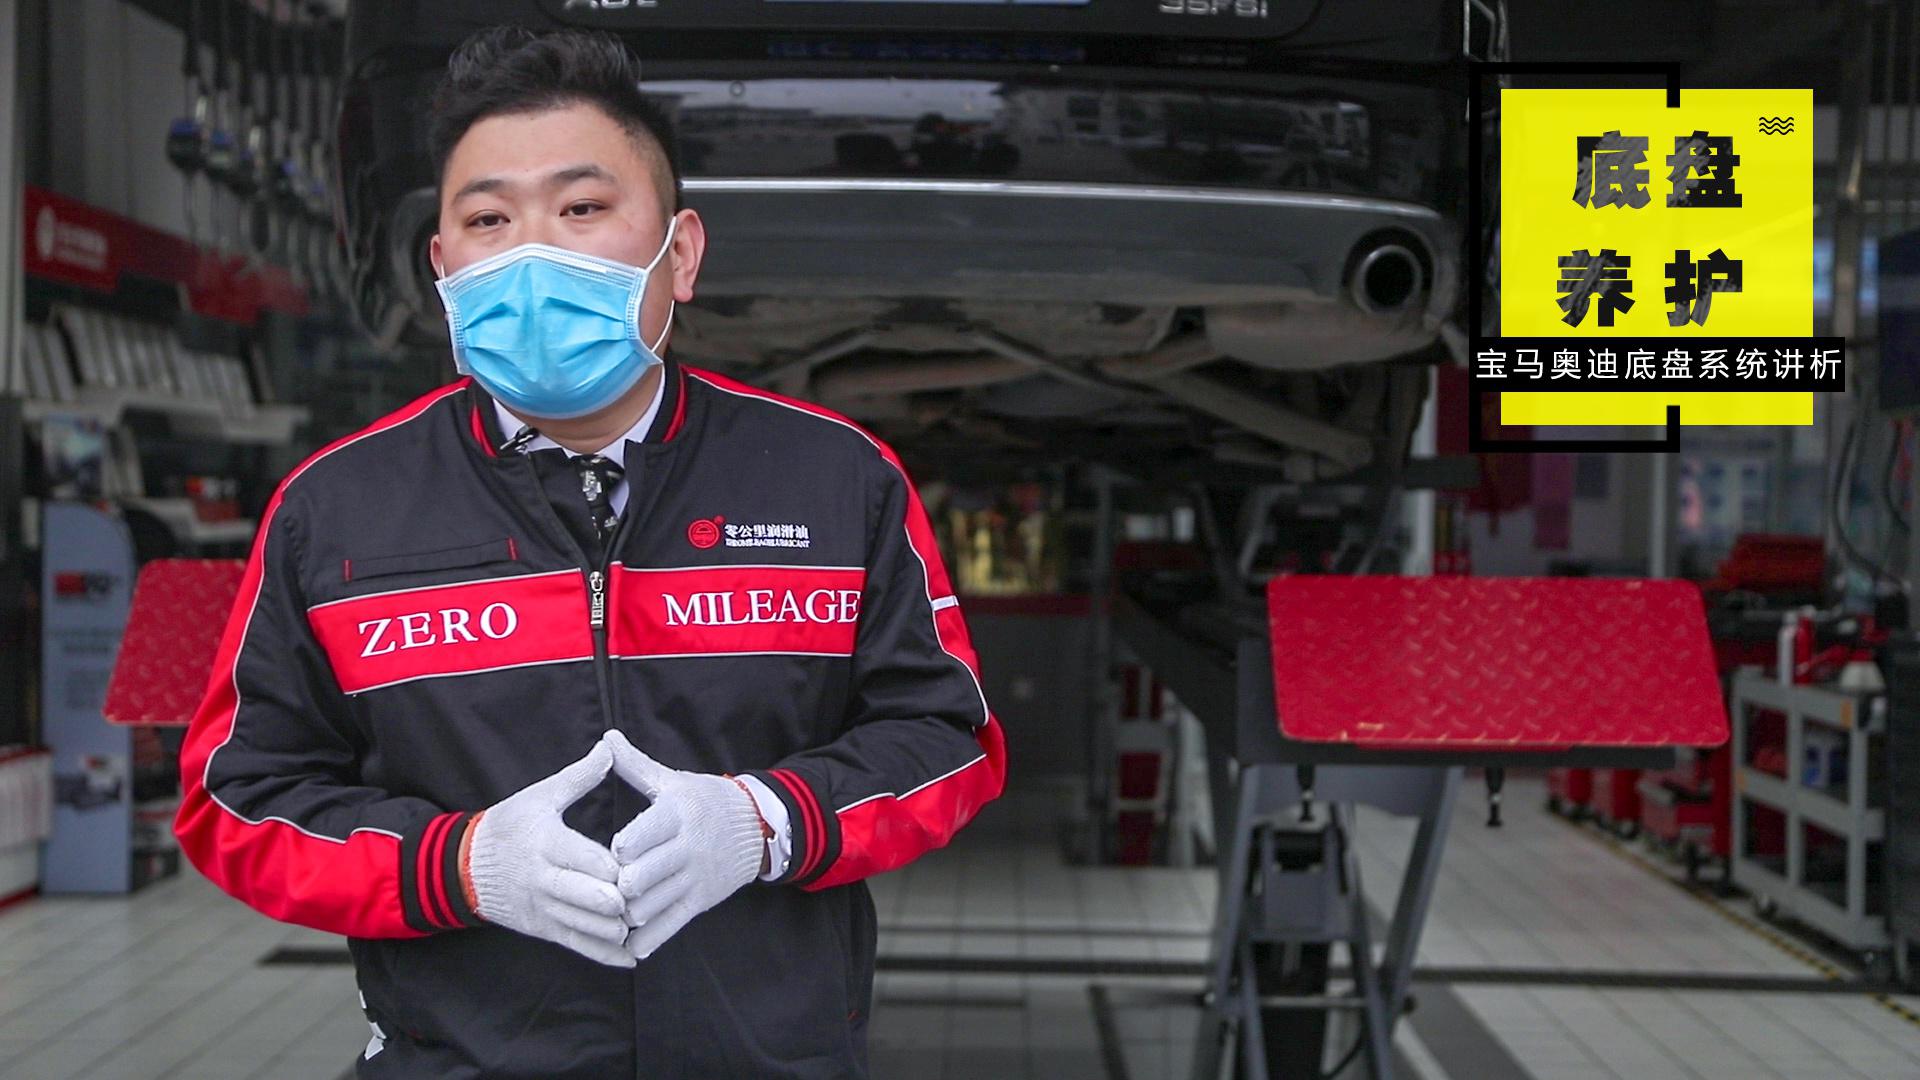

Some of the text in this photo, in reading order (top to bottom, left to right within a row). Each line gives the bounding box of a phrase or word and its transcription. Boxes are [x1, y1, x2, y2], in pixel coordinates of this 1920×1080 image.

[724, 523, 809, 539] 零公里润滑油
[358, 589, 861, 658] ZERO MILEAGE
